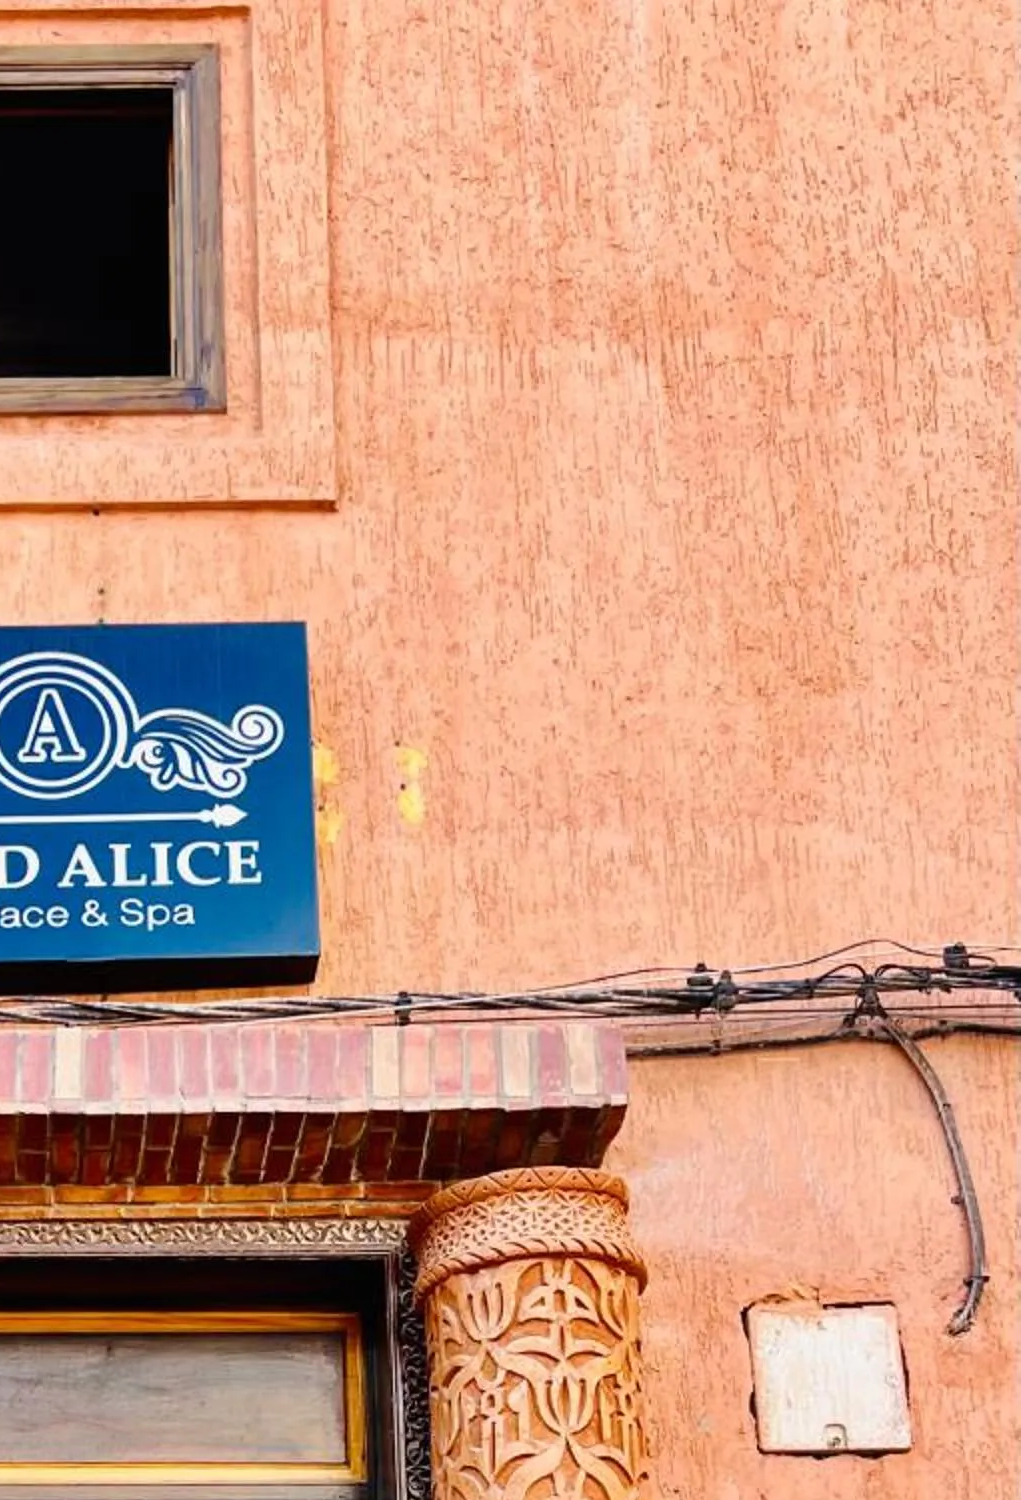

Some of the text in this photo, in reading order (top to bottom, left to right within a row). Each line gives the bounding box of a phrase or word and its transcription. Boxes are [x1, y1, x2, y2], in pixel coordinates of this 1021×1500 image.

[17, 688, 86, 763] A
[57, 840, 263, 888] ALICE
[81, 899, 108, 928] &
[120, 898, 196, 931] Spa
